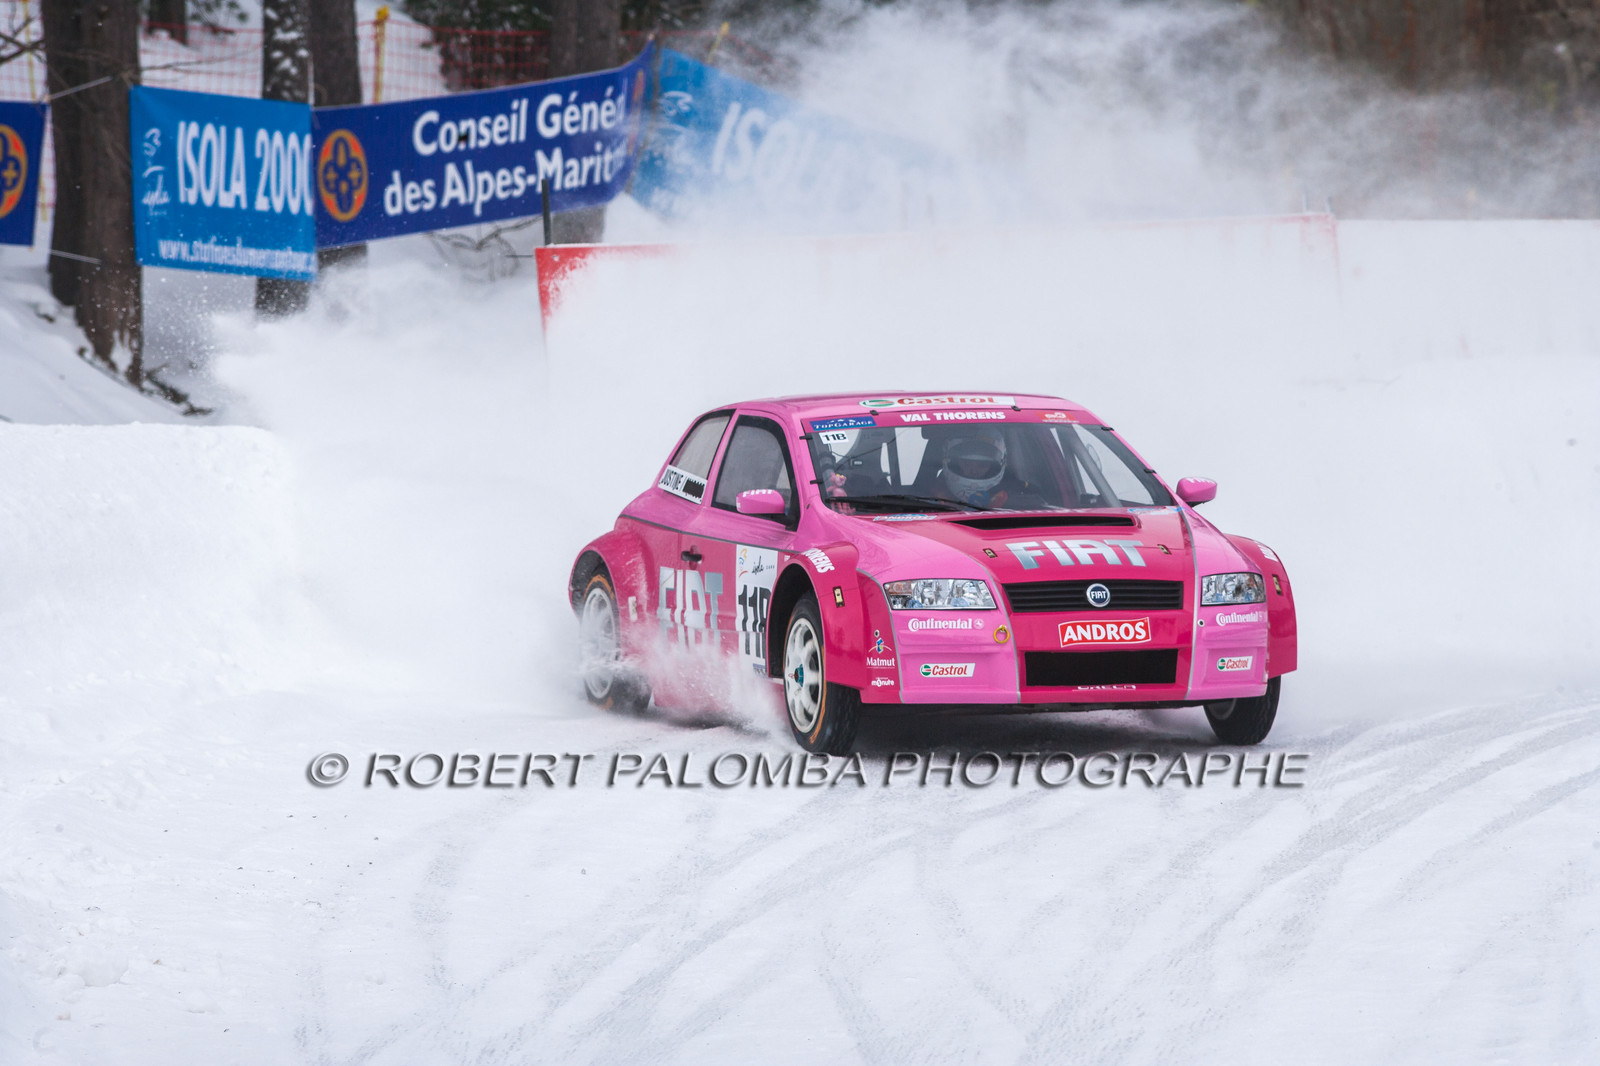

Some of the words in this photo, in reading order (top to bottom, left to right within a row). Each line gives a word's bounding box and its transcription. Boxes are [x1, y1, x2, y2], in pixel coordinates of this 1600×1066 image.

[412, 98, 529, 156] Conseil
[177, 120, 248, 209] ISOLA
[384, 171, 437, 217] des
[897, 396, 1000, 405] Castrol
[900, 412, 931, 423] VAL
[933, 411, 1006, 421] THORENS
[822, 433, 847, 441] 11B
[742, 489, 773, 498] FIAT
[1005, 539, 1146, 570] FIAT
[1090, 590, 1107, 599] FIAT
[657, 566, 723, 652] FIAT
[908, 618, 972, 632] Continental
[1216, 611, 1259, 626] Continental
[1063, 621, 1147, 643] ANDROS
[866, 657, 895, 667] Matmut
[1226, 658, 1249, 669] Castrol
[932, 665, 968, 675] Castrol
